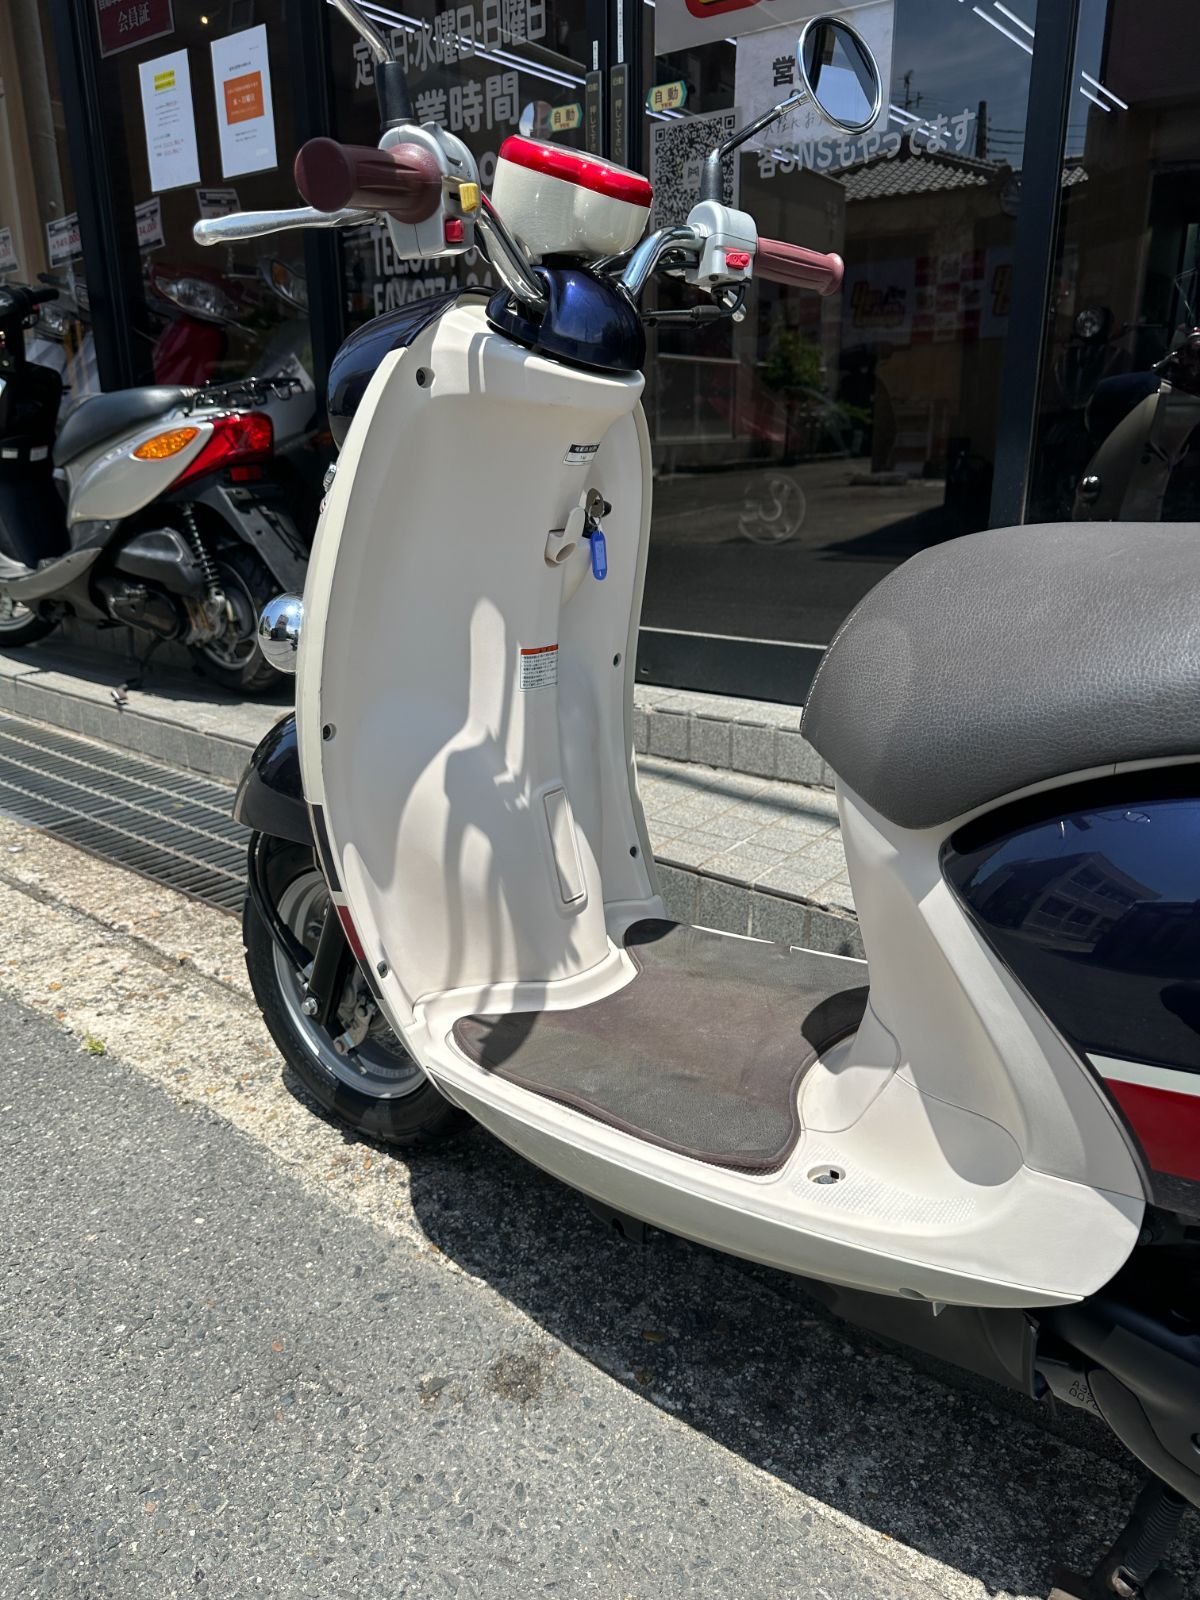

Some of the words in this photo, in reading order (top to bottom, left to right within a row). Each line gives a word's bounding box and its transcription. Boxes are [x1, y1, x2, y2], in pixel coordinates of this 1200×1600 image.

[118, 2, 151, 33] 会員証
[773, 55, 796, 87] 営
[414, 71, 519, 133] 業時間
[655, 85, 679, 105] 自動
[553, 108, 576, 126] 自動
[757, 108, 976, 179] 各SNSもやってます
